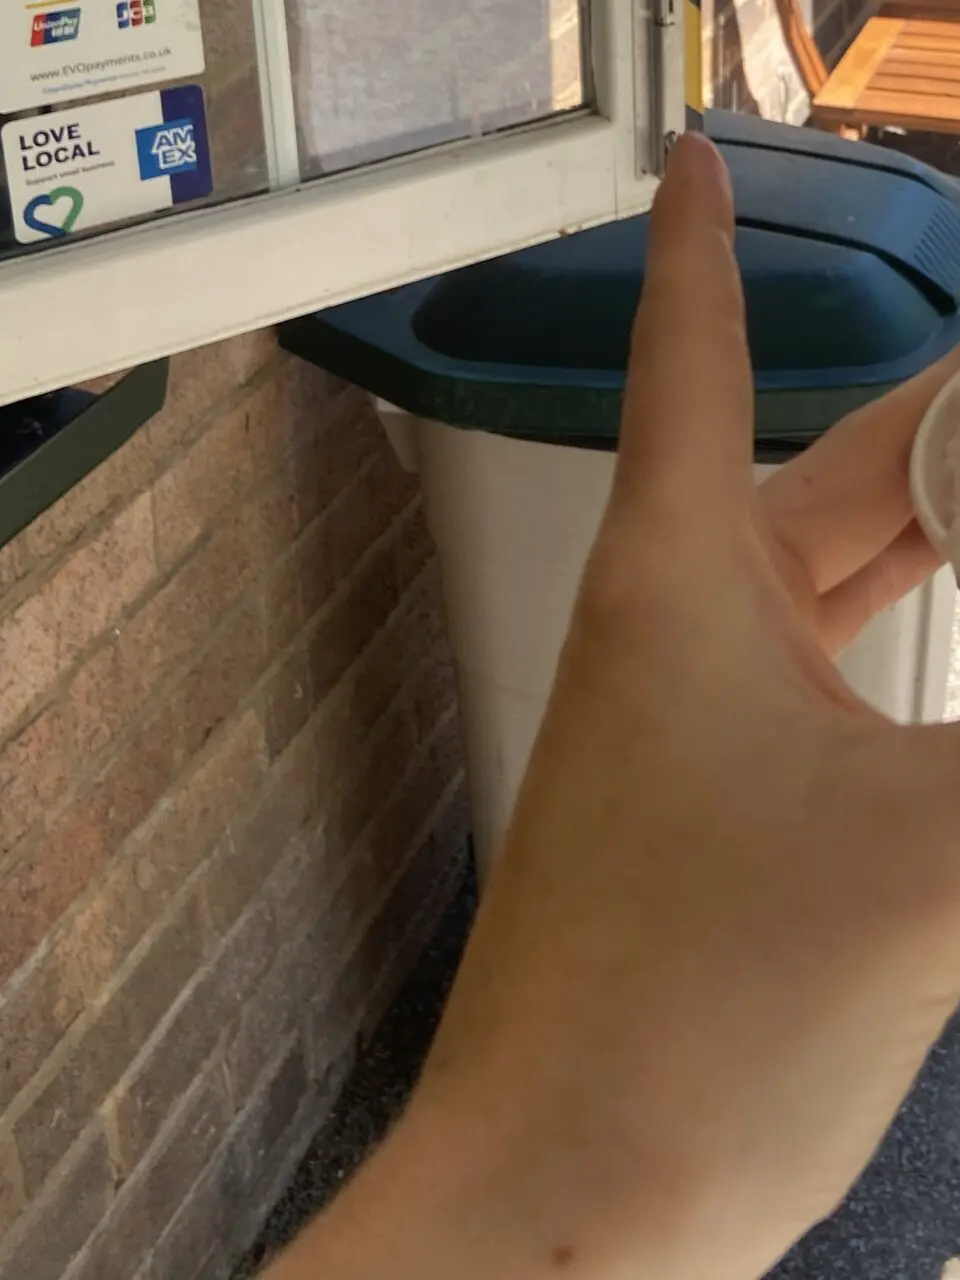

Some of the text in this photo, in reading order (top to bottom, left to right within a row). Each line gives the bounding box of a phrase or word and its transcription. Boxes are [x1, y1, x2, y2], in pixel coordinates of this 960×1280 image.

[30, 46, 172, 82] www.EVOpayments.co.uk
[19, 123, 81, 150] LOVE
[22, 140, 100, 171] LOCAL
